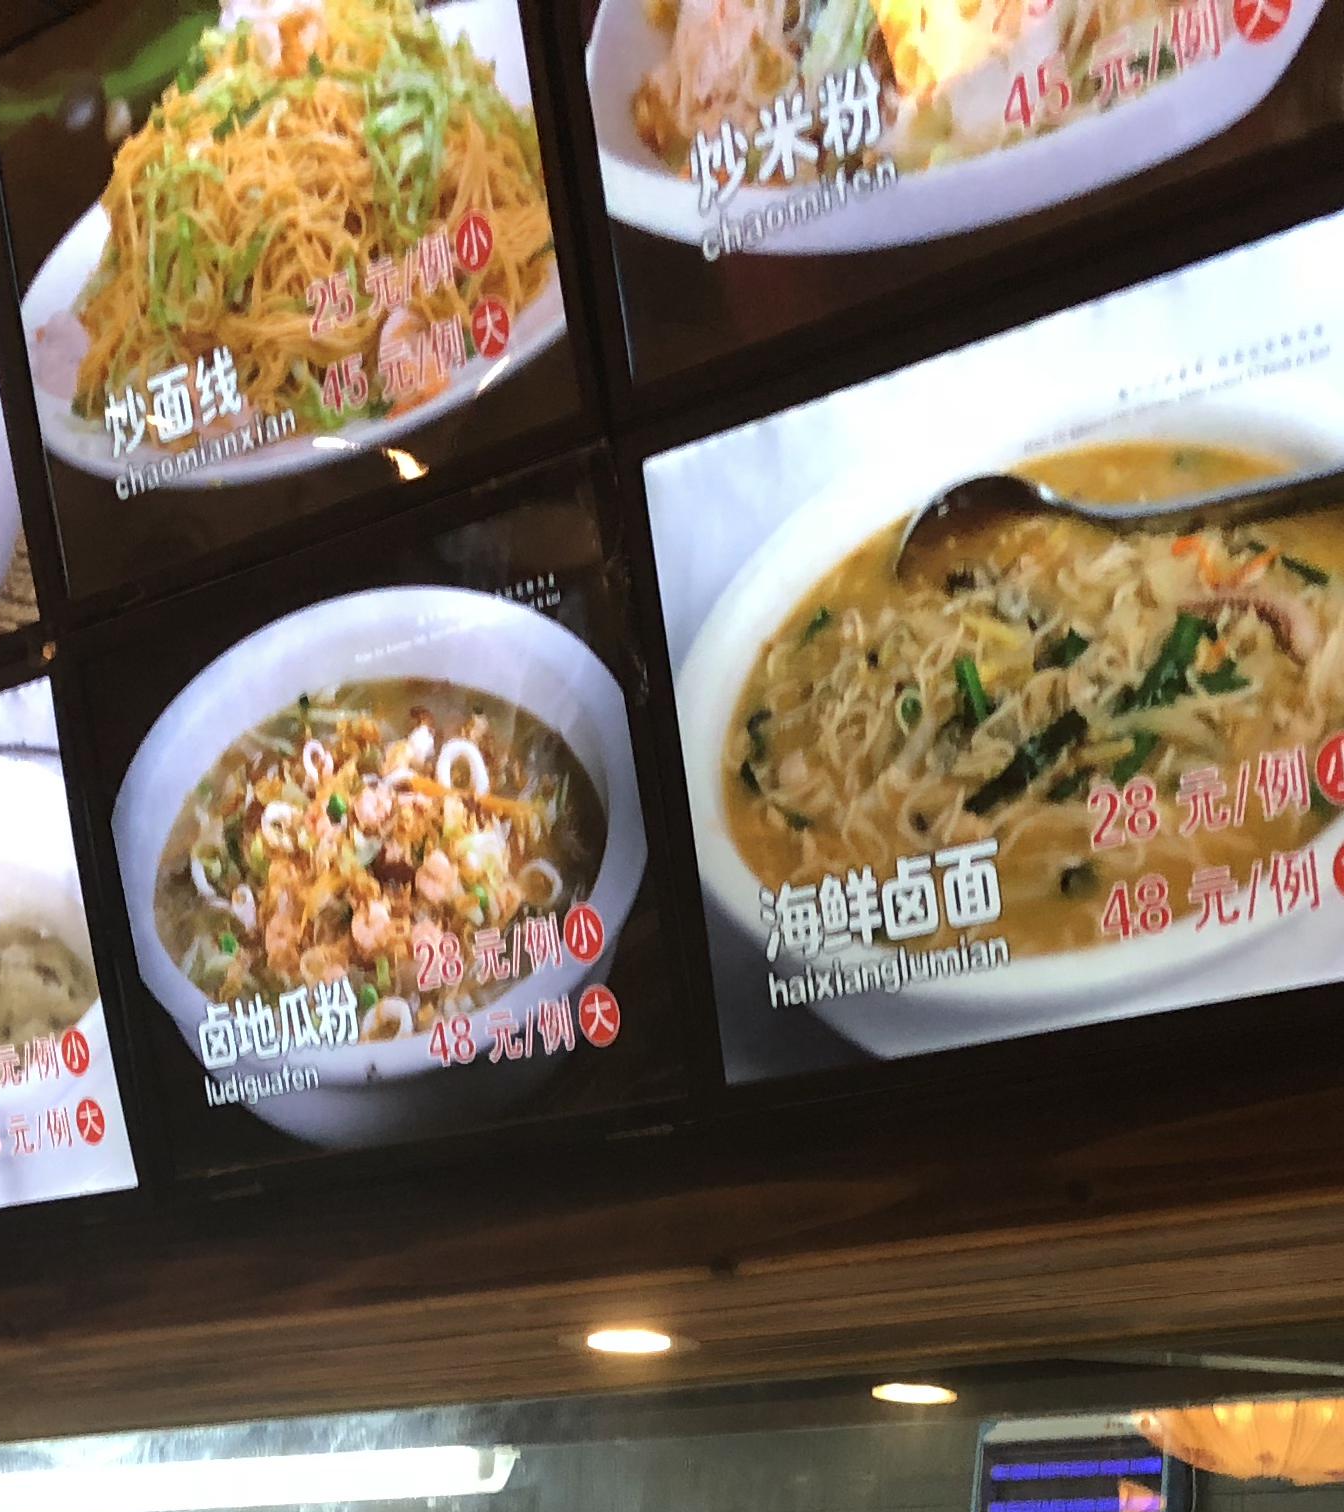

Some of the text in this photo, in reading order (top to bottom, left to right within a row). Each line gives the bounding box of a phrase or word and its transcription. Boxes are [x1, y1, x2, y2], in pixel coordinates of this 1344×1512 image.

[690, 56, 882, 216] 炒米粉
[1004, 56, 1071, 127] 45
[306, 214, 491, 340] 25 元/例 小
[103, 345, 244, 458] 炒面线
[322, 304, 509, 414] 45 元/例 大
[115, 407, 298, 502] chaomianxian
[1088, 780, 1159, 851] 28
[1176, 746, 1313, 838] 元/例
[758, 838, 1004, 964] 海鲜卤面
[1100, 880, 1173, 943] 48
[1187, 847, 1322, 935] 元/例
[413, 907, 600, 992] 28 元/例 小
[768, 933, 1010, 1010] haixianglumian
[62, 1029, 90, 1075] 小
[197, 973, 360, 1071] 卤地瓜粉
[428, 989, 618, 1068] 48 元/例 大
[9, 1106, 73, 1155] 元/例
[77, 1099, 106, 1143] 大
[203, 1061, 320, 1108] ludiguafen
